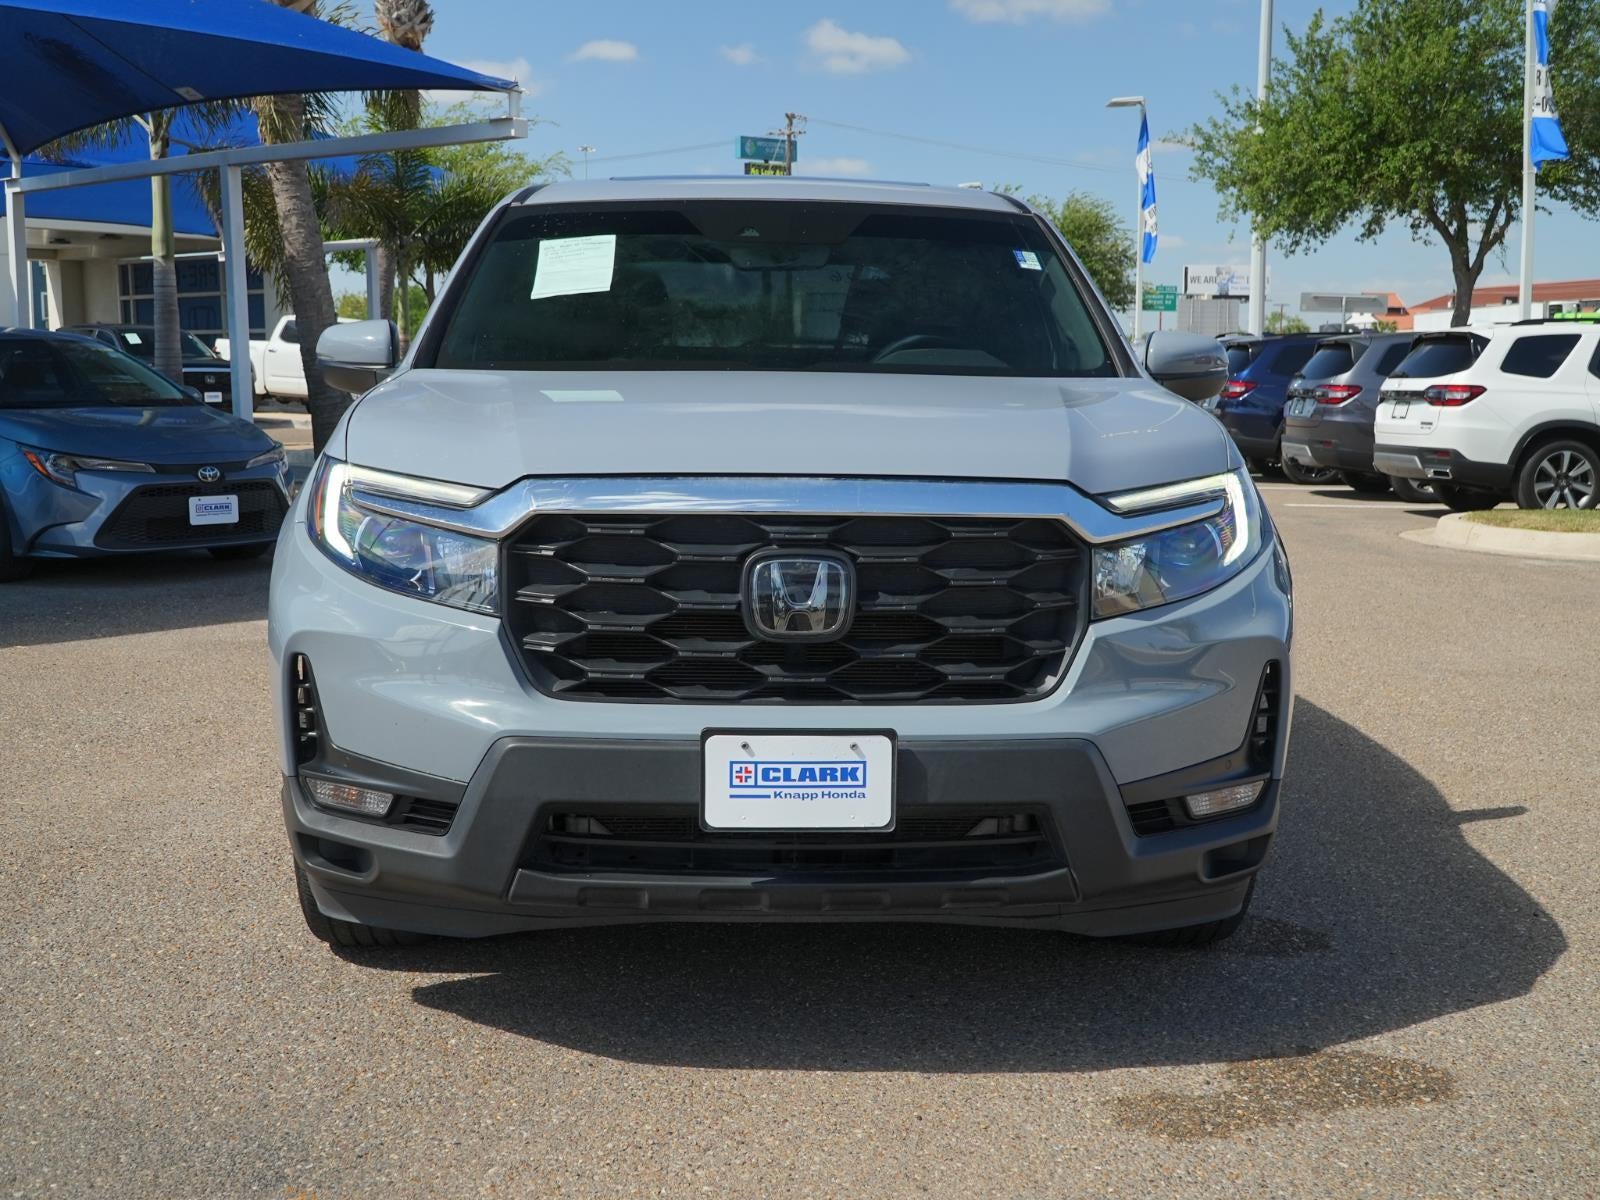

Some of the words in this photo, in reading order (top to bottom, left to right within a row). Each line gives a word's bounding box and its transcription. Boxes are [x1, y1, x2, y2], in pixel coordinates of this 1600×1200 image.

[1190, 275, 1201, 284] WE
[761, 766, 860, 782] CLARK
[773, 791, 819, 801] Knapp
[821, 790, 866, 799] Honda
